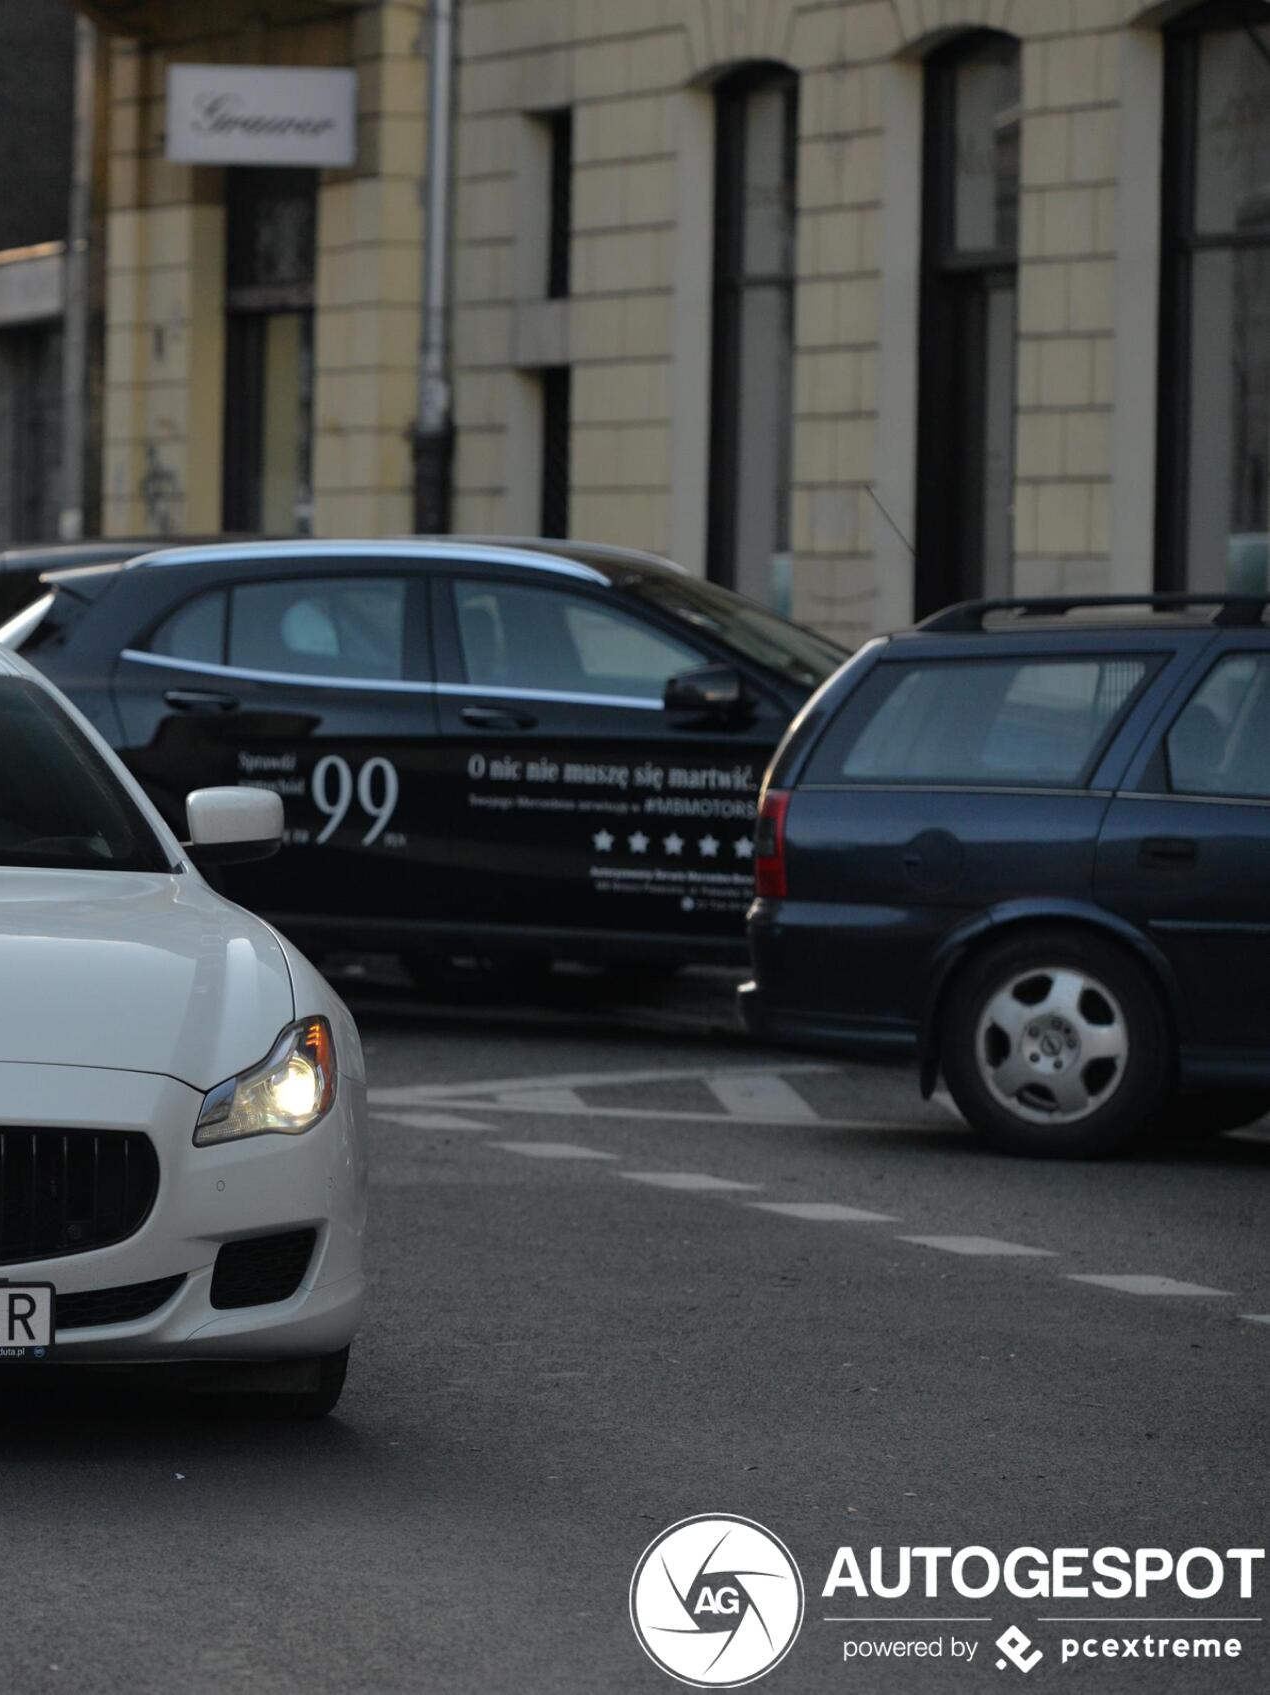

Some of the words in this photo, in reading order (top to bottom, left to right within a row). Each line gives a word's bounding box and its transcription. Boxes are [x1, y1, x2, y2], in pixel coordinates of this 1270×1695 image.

[311, 755, 399, 846] 99
[468, 754, 486, 779] O
[489, 757, 521, 781] nic
[526, 758, 559, 782] nie
[562, 763, 628, 789] muszę
[634, 761, 663, 790] się
